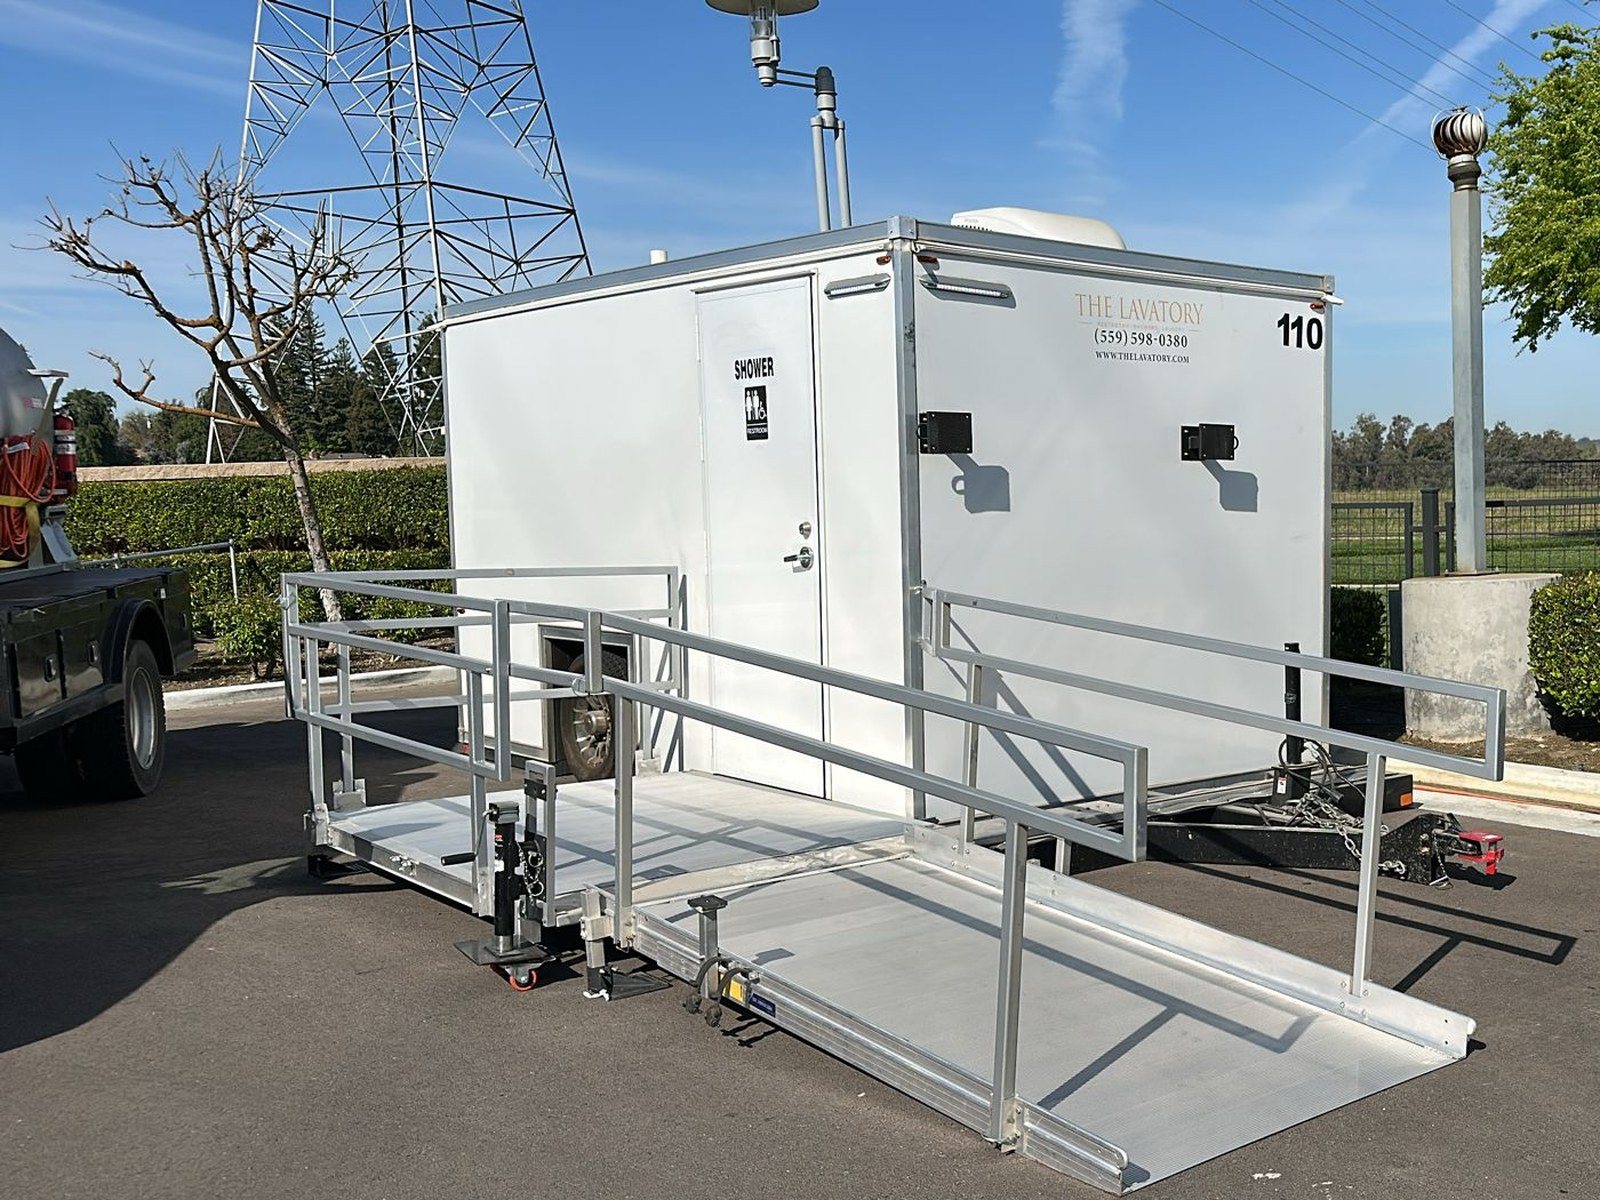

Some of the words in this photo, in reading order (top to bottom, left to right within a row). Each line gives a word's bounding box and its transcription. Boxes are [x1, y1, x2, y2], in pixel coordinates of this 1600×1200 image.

[1075, 293, 1113, 318] THE
[1120, 297, 1204, 325] LAVATORY
[1094, 327, 1128, 346] (559)
[1130, 331, 1188, 348] 598-0380
[1277, 312, 1323, 350] 110
[734, 356, 775, 380] SHOWER
[1095, 350, 1190, 363] WWW.THELAVATORY.COM
